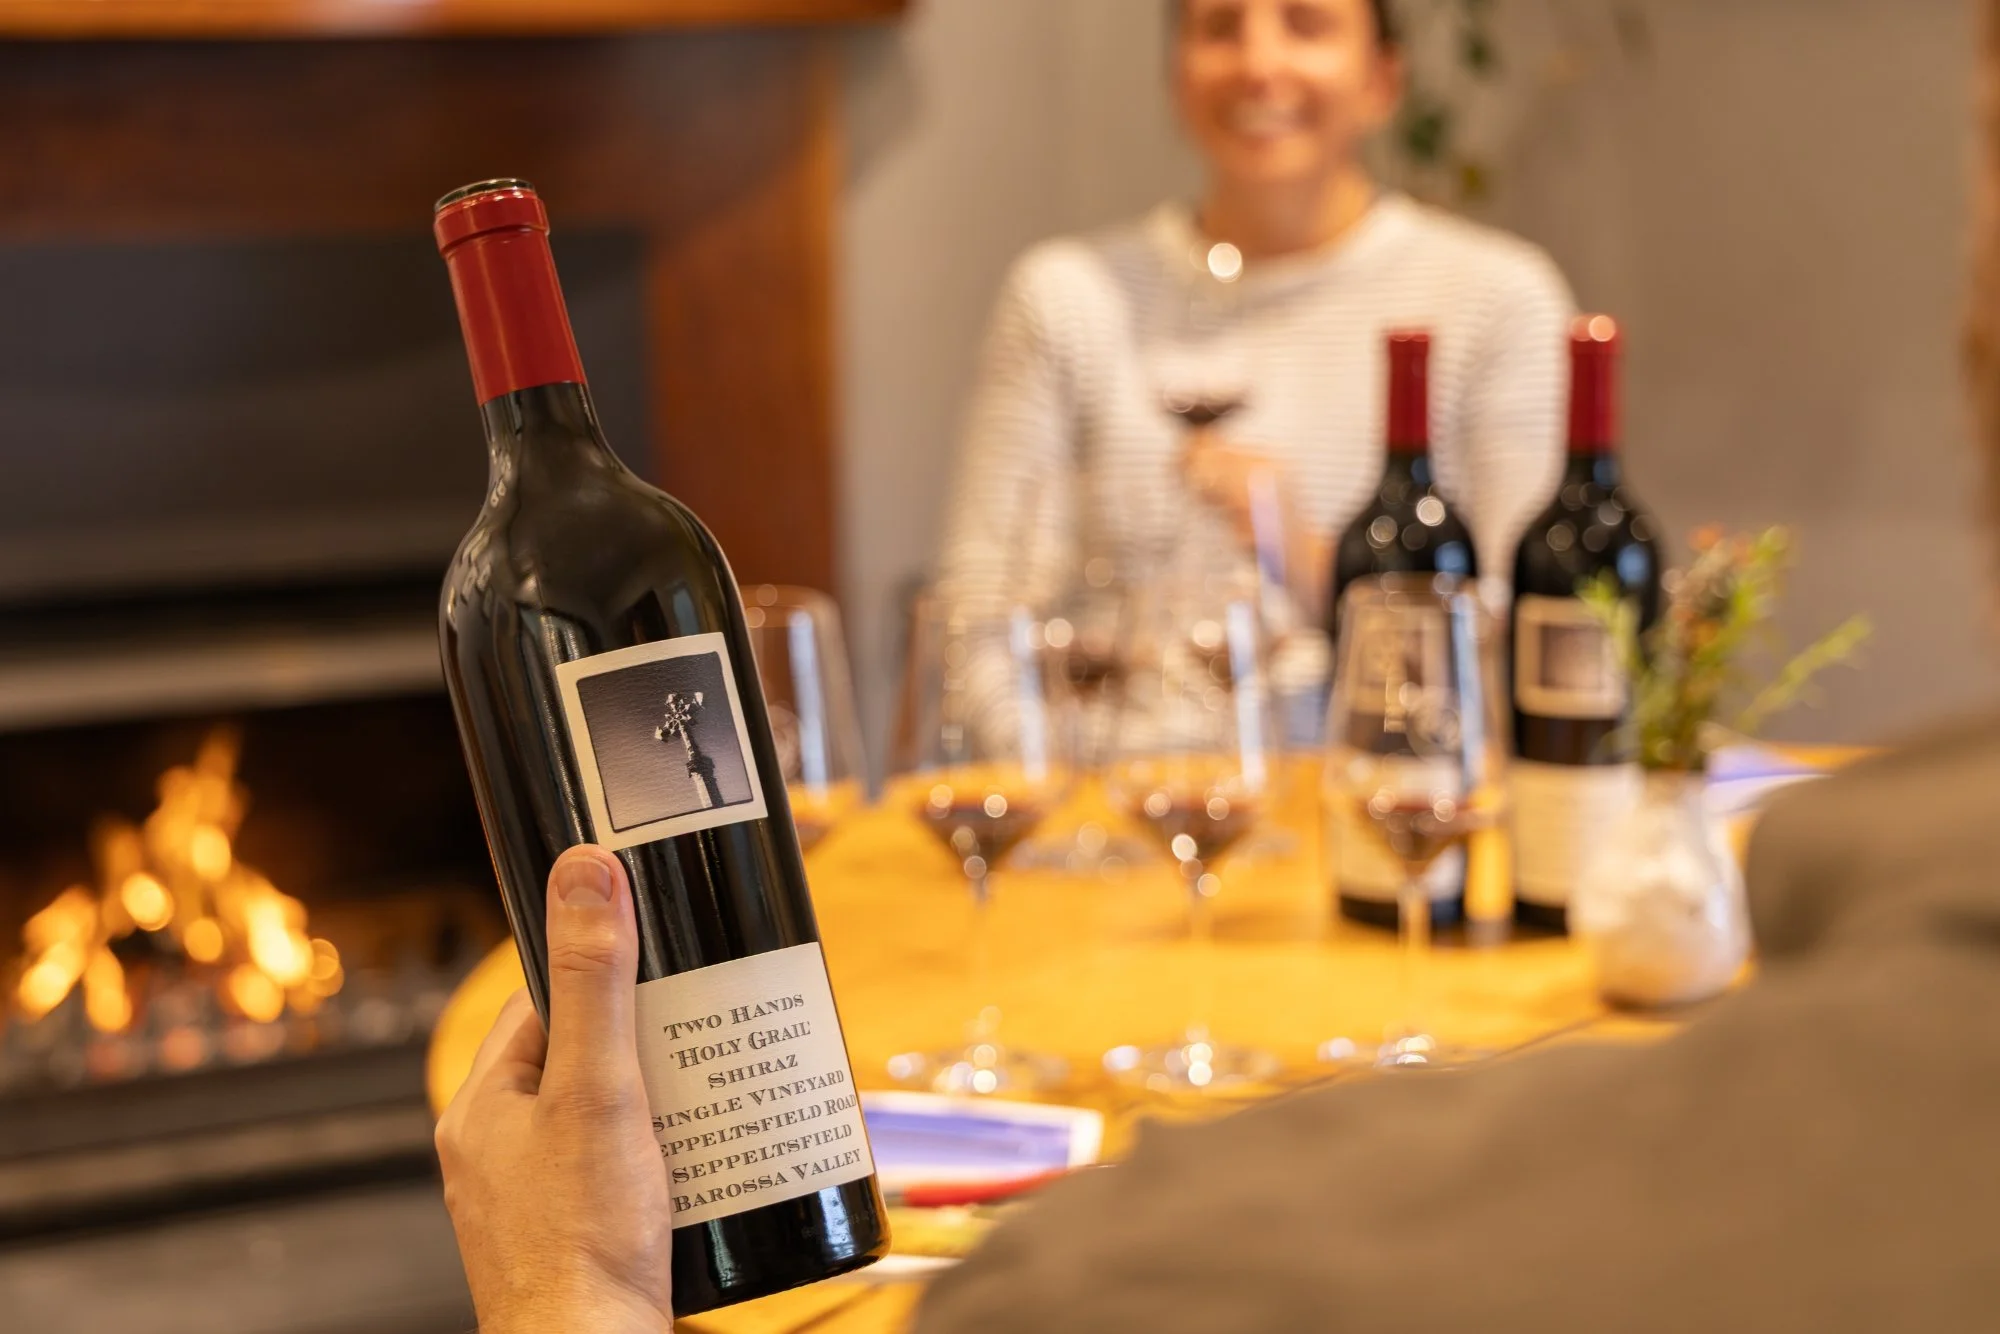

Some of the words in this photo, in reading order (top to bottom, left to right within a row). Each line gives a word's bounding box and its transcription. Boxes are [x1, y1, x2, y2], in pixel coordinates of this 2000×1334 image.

[664, 1014, 722, 1041] TWO
[729, 994, 804, 1024] HANDS
[708, 1054, 798, 1089] SHIRAZ
[652, 1096, 742, 1132] SINGLE
[748, 1070, 844, 1106] VINEYARD
[824, 1093, 857, 1116] ROAD
[672, 1124, 852, 1184] SEPPELTSFIELD
[672, 1171, 788, 1213] BAROSSA
[792, 1149, 861, 1180] VALLEY
